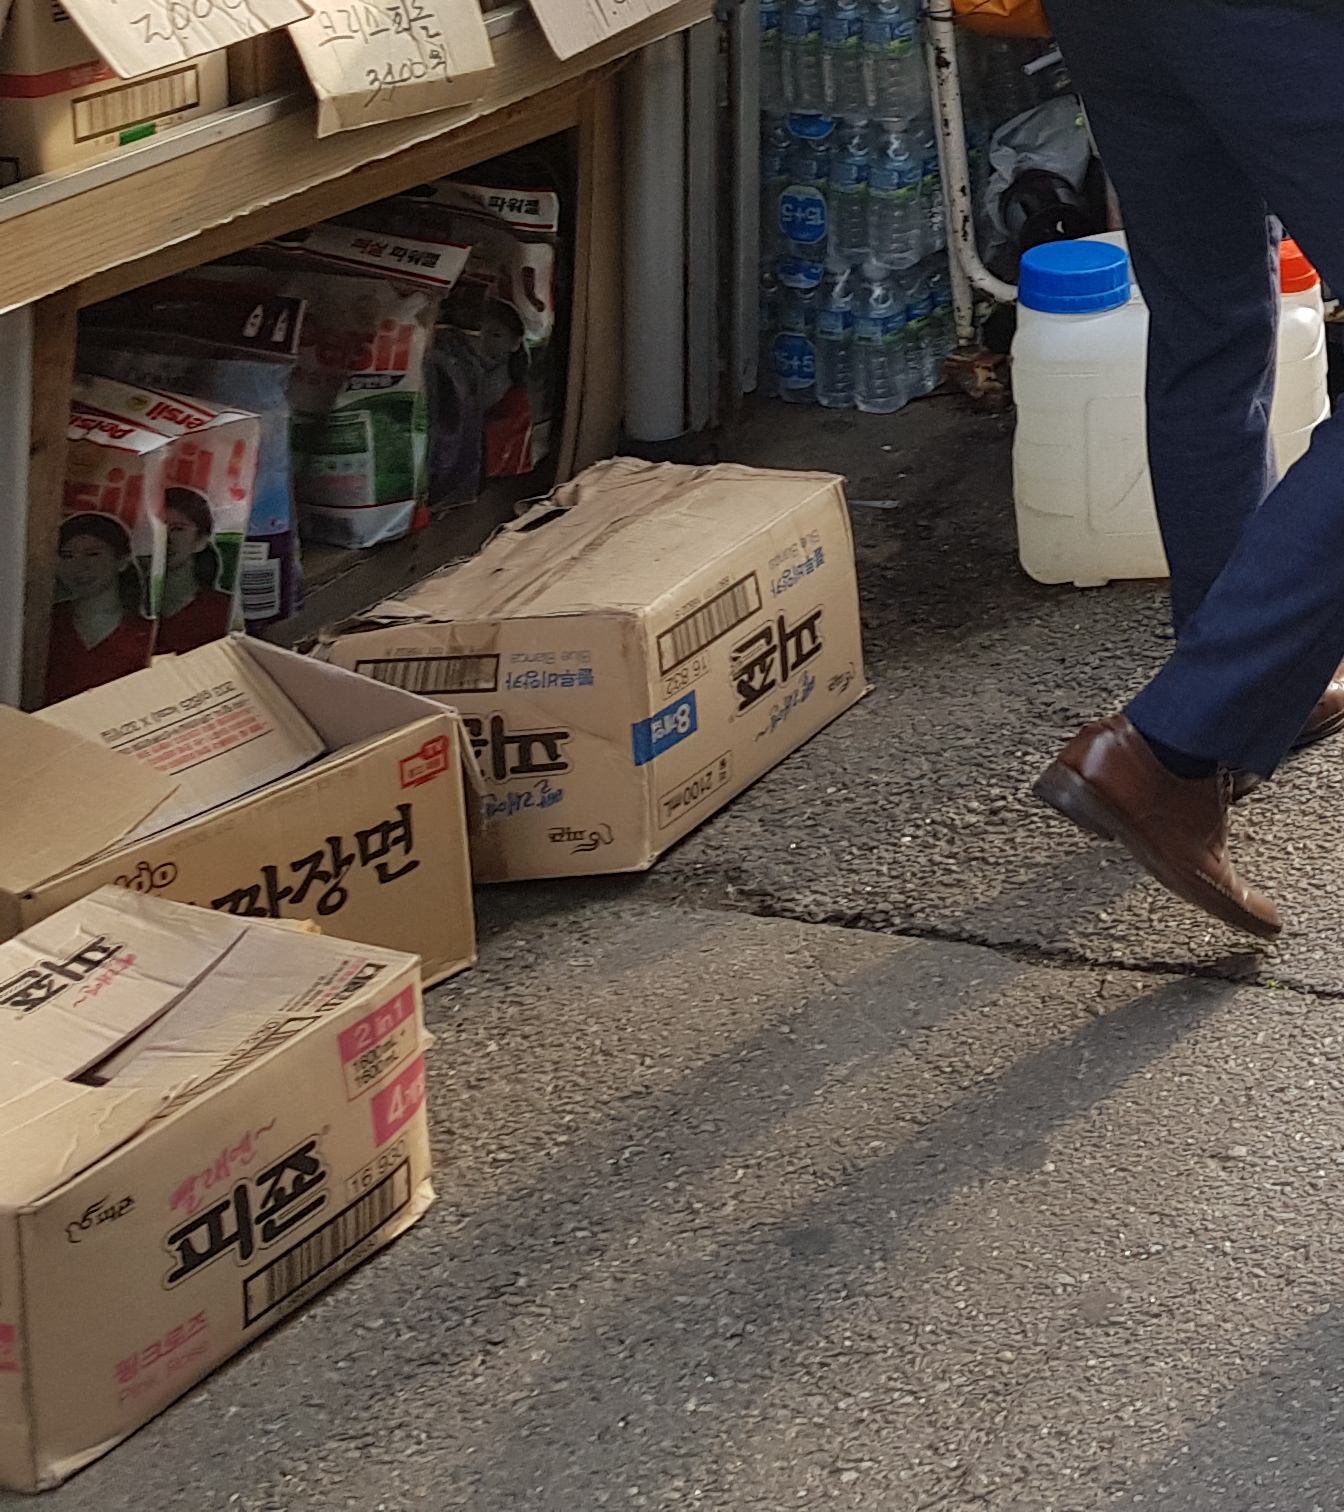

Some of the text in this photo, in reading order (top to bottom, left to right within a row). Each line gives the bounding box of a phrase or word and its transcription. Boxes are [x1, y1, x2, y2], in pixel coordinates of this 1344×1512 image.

[731, 609, 823, 712] 피죤
[354, 1022, 372, 1050] 2
[393, 997, 404, 1020] 1
[168, 1139, 327, 1284] 피죤
